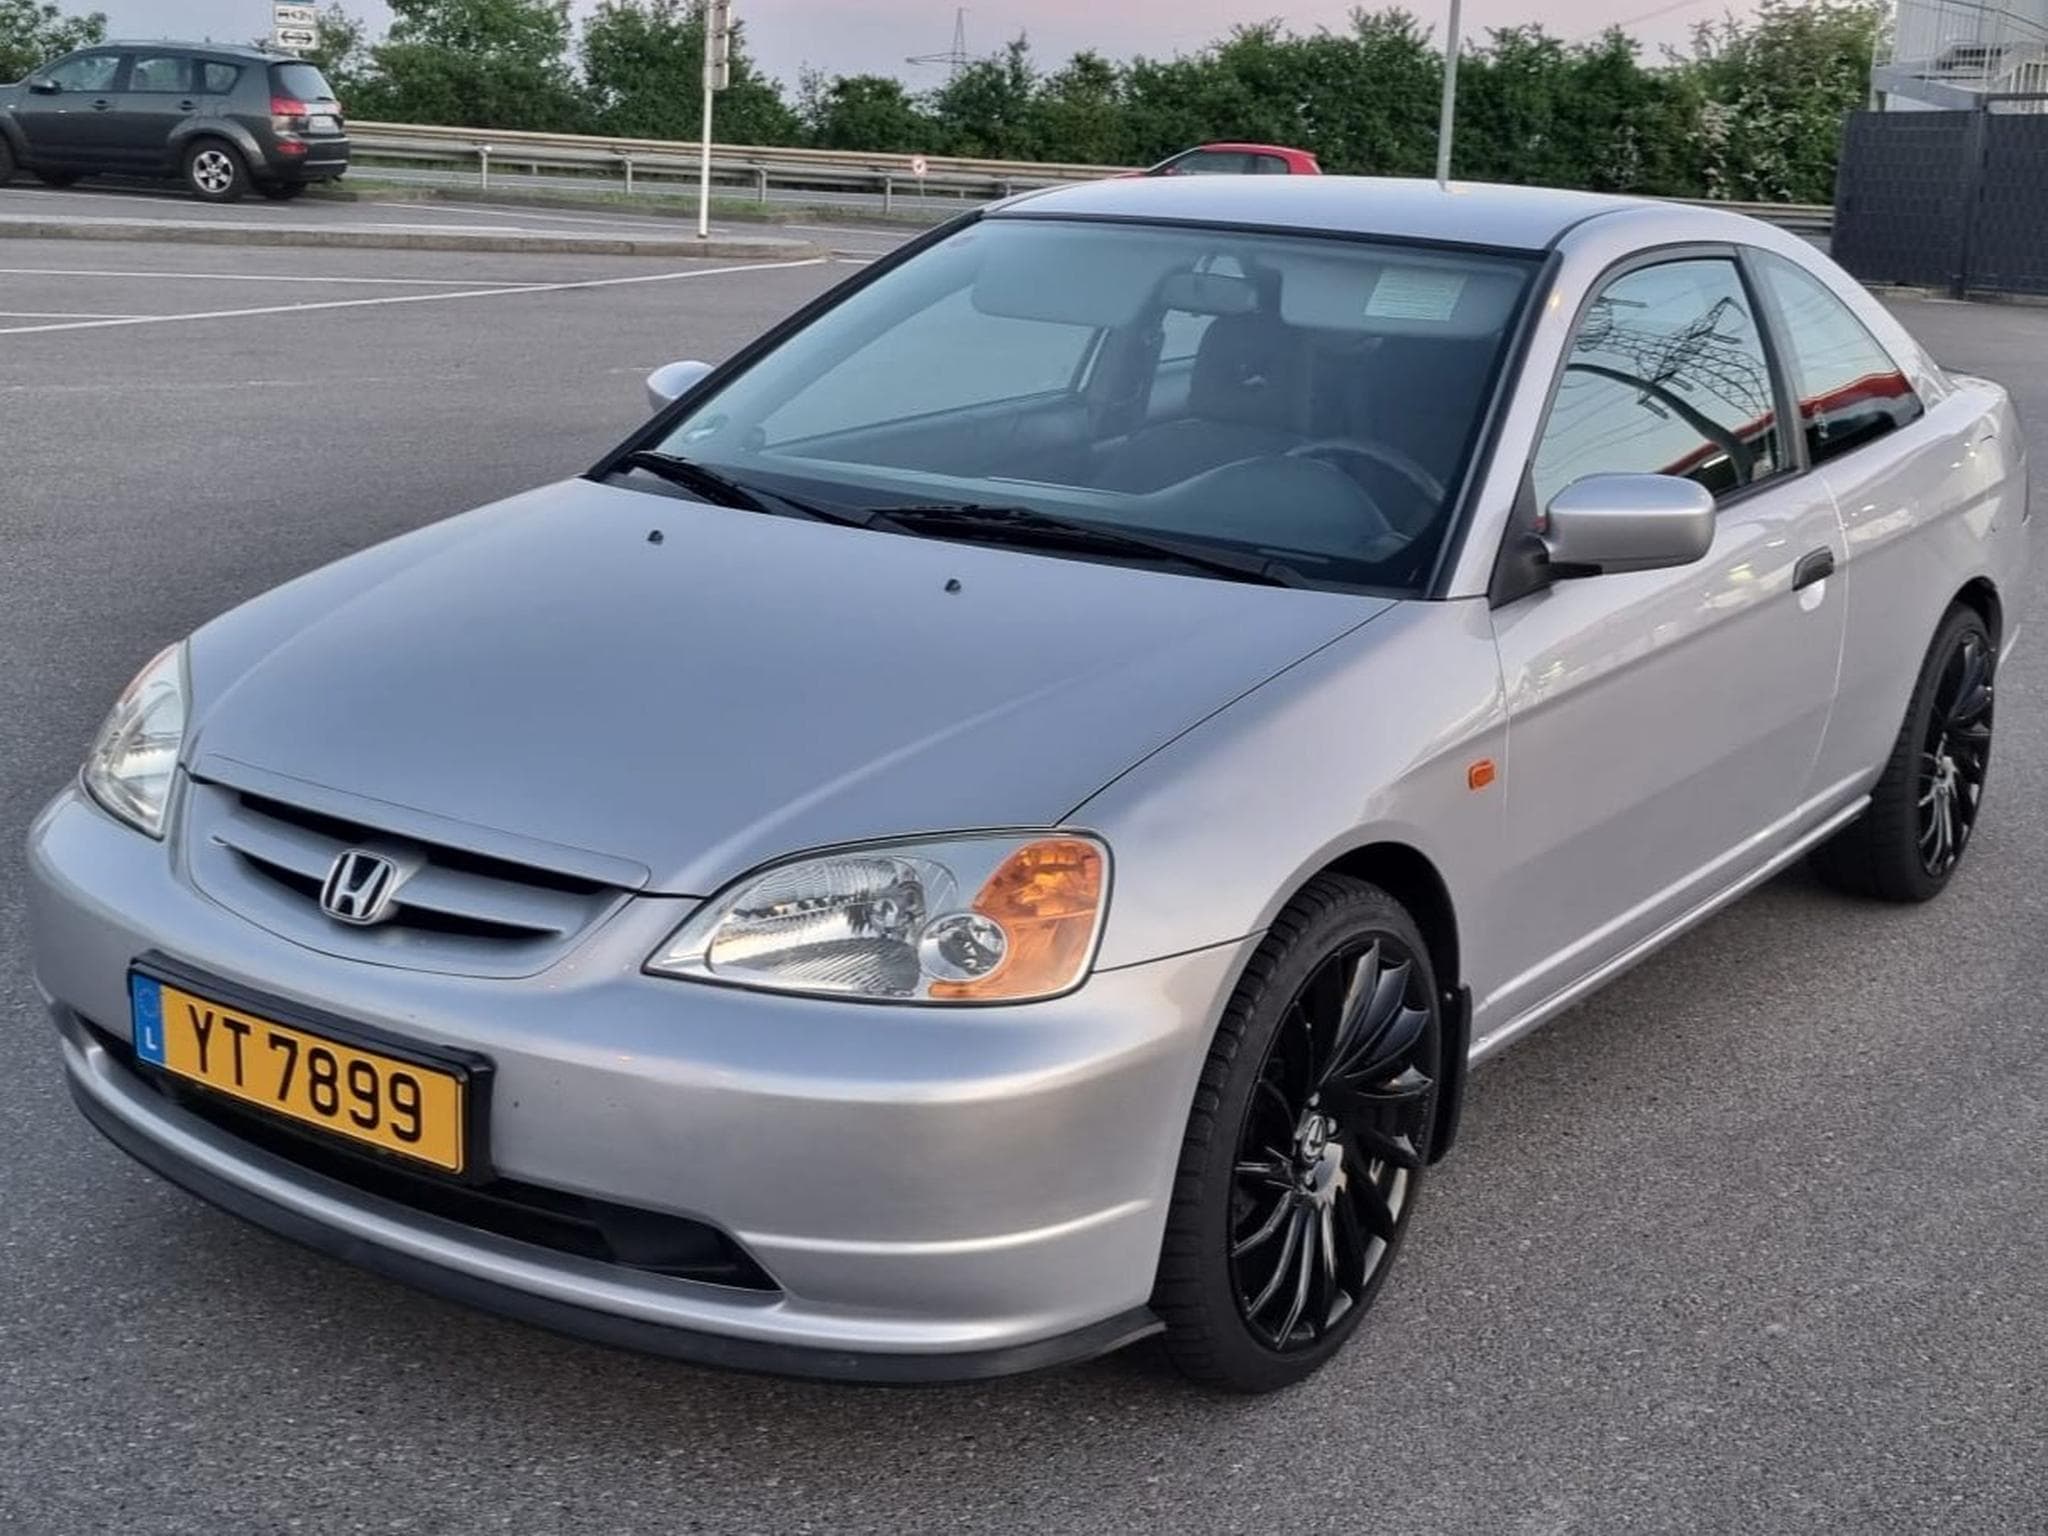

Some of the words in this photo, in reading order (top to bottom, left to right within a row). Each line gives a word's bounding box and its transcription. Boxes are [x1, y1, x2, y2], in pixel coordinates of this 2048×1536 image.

[145, 1026, 158, 1050] L
[188, 1004, 250, 1086] YT
[269, 1033, 422, 1143] 7899
